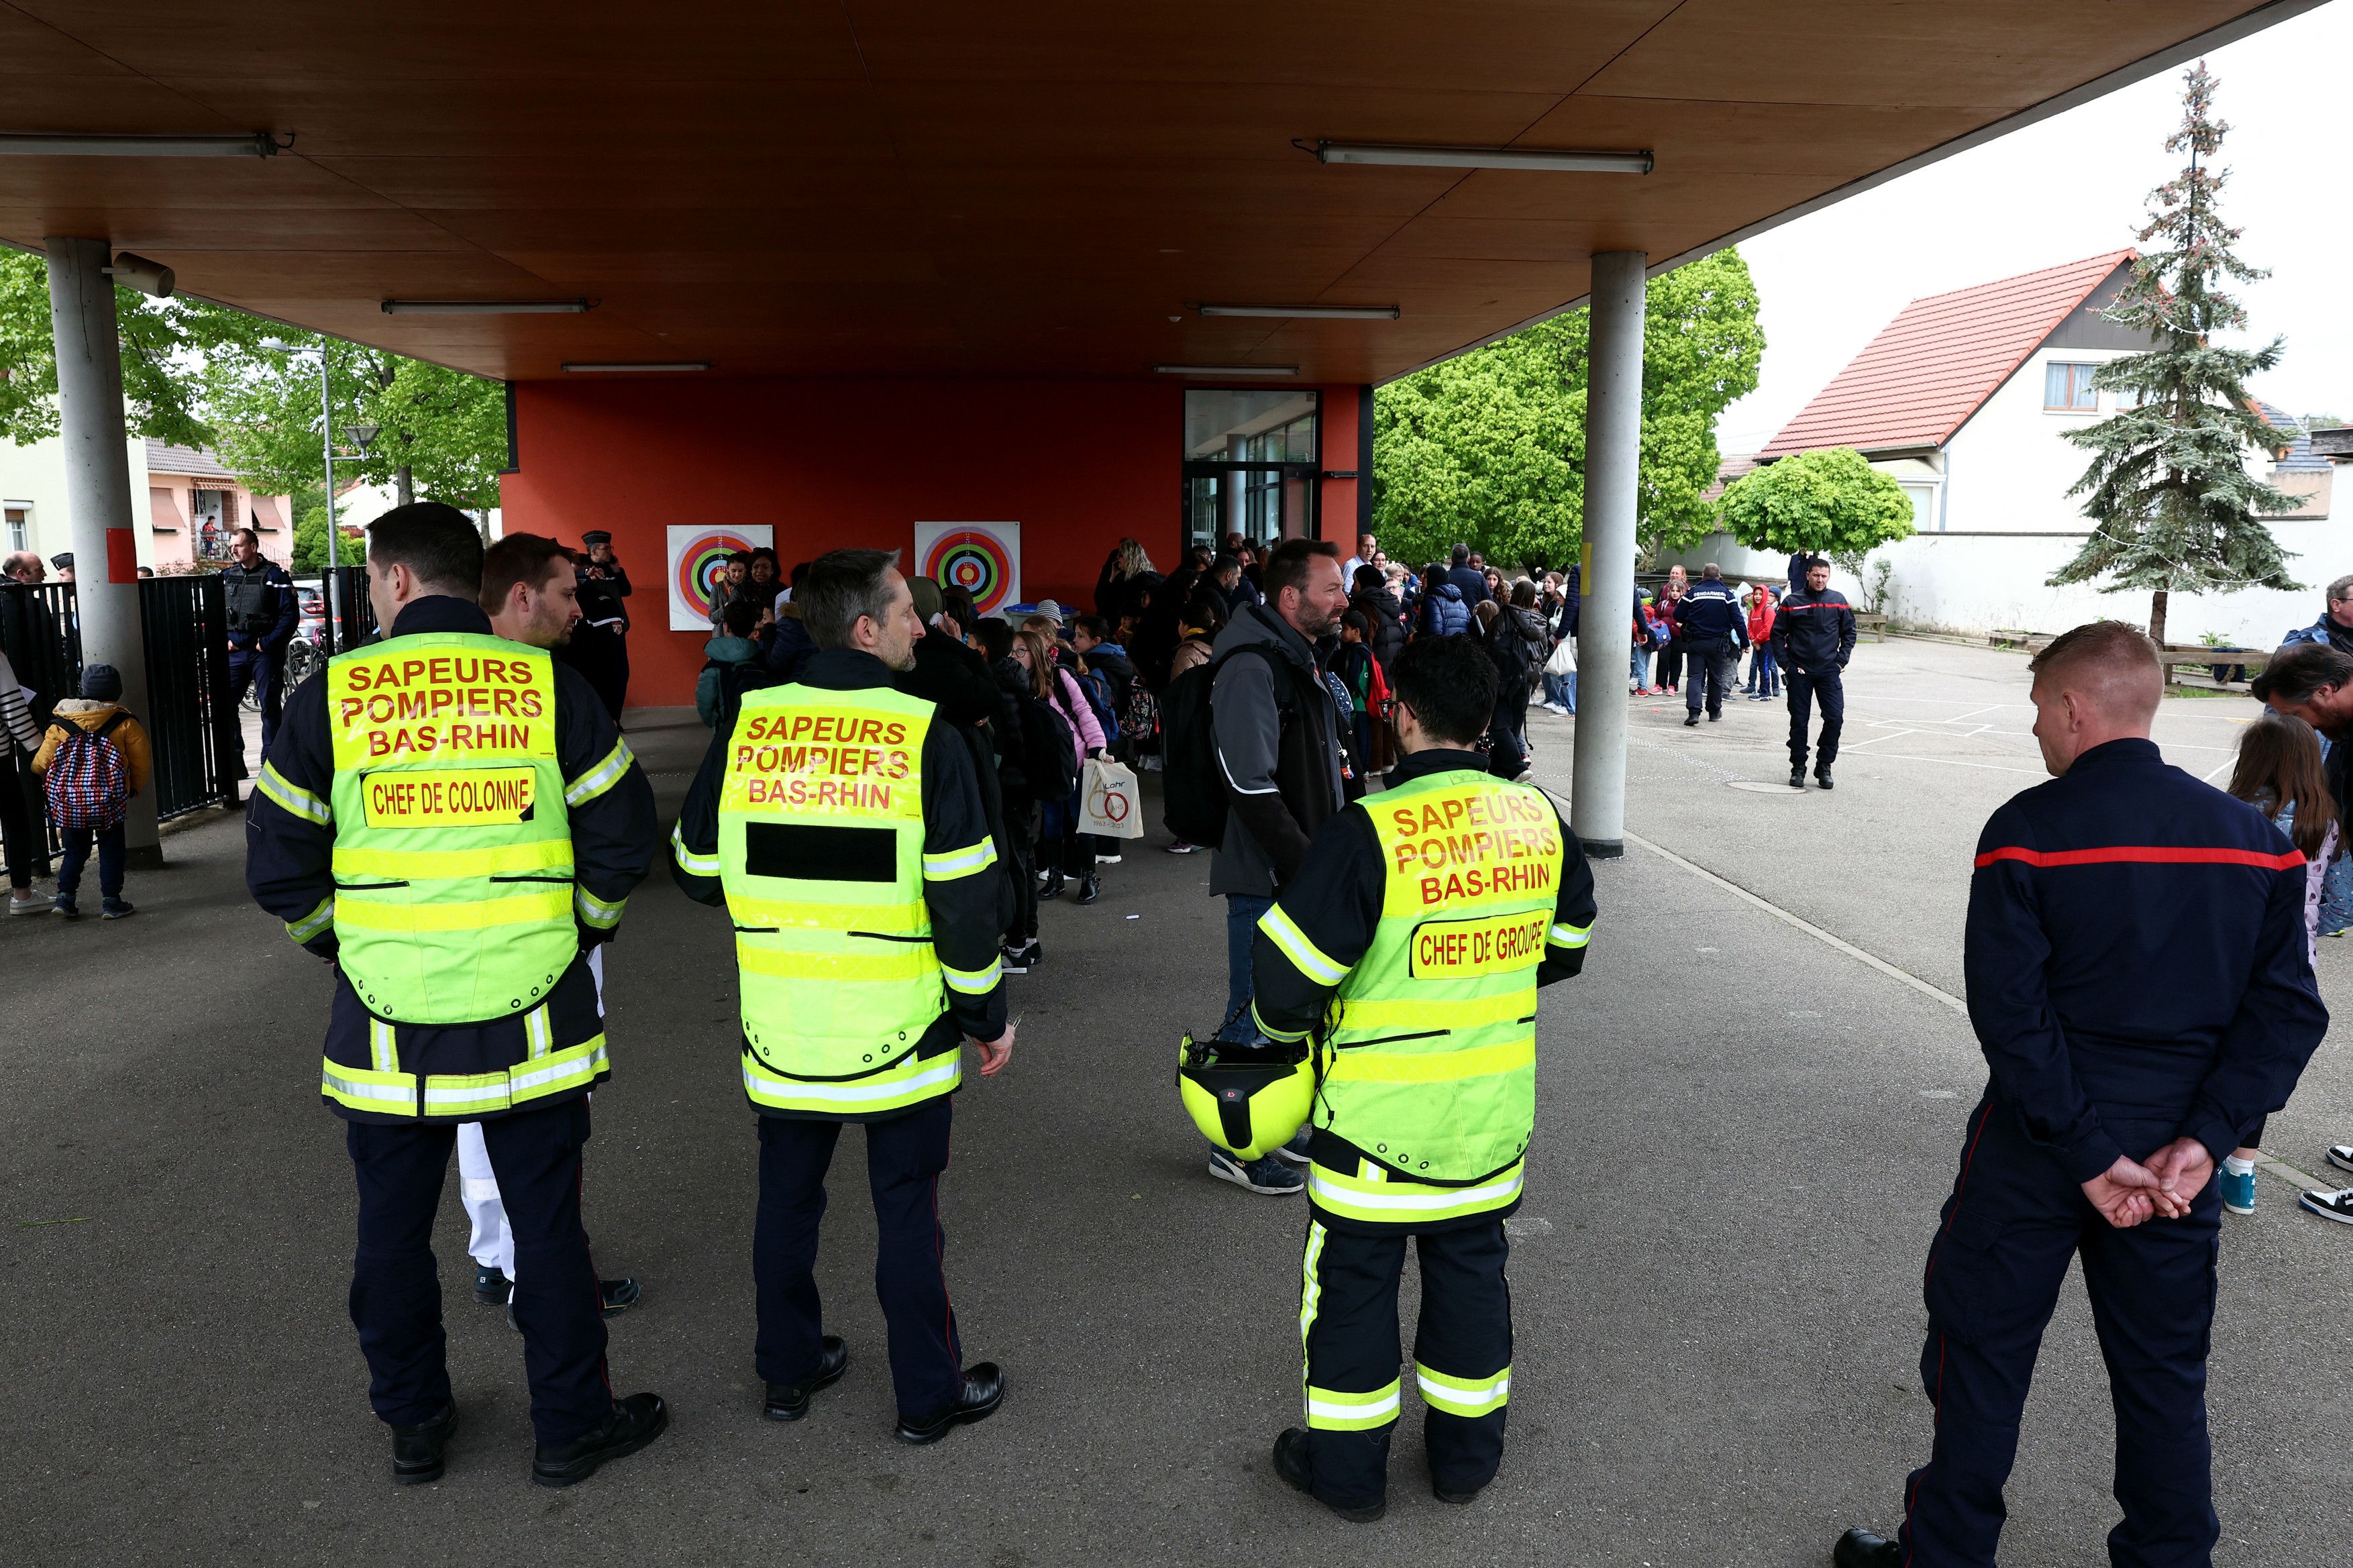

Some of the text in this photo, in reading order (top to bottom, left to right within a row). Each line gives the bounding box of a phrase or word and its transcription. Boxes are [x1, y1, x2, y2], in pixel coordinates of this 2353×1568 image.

[348, 658, 533, 692] SAPEURS
[341, 688, 543, 728] POMPIERS
[368, 725, 529, 757] BAS-RHIN
[746, 716, 906, 745] SAPEURS
[736, 745, 909, 779] POMPIERS
[373, 779, 529, 815] CHEF DE COLONNE
[749, 779, 890, 809] BAS-RHIN
[1393, 795, 1543, 837] SAPEURS
[1394, 828, 1557, 874] POMPIERS
[1420, 863, 1550, 904] BAS-RHIN
[1420, 920, 1545, 965] CHEF DE GROUPE
